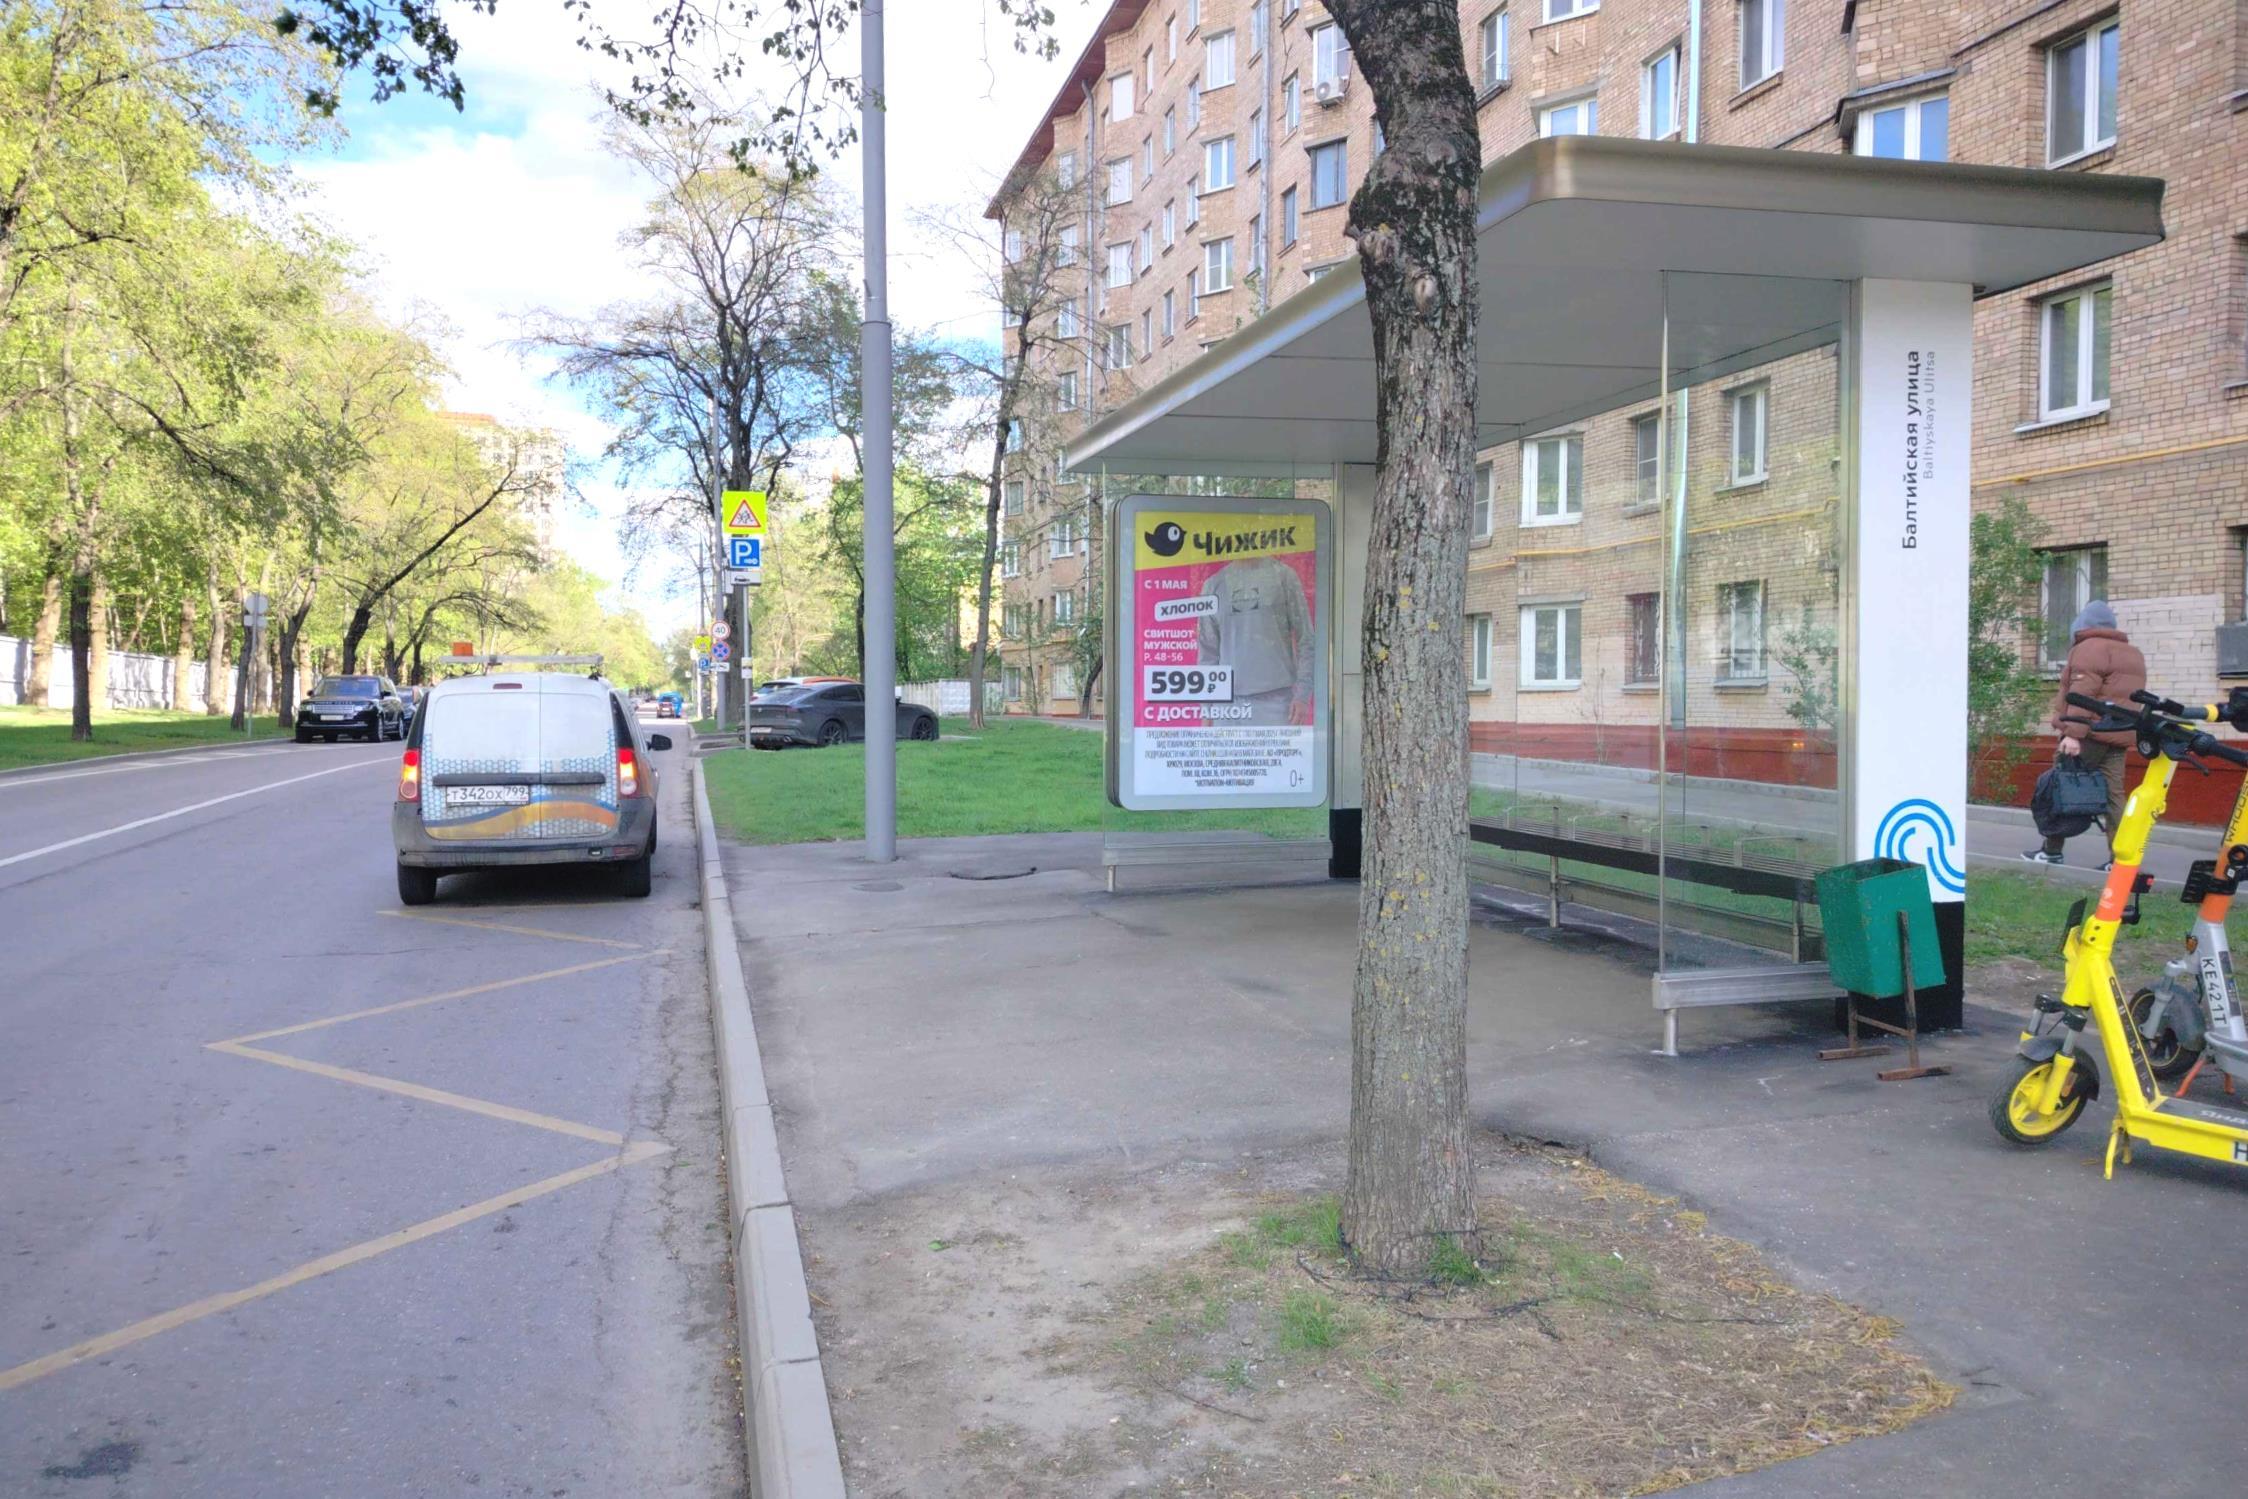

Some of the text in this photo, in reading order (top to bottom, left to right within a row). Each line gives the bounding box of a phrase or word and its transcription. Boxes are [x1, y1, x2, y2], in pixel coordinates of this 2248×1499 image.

[1923, 351, 1936, 479] Baltiyskaya Ulitsa
[1902, 350, 1922, 549] Балтийская улица
[735, 541, 752, 565] P
[1144, 579, 1188, 590] С 1 МАЯ
[1160, 600, 1214, 616] ХЛОПОК
[715, 626, 726, 634] 40
[1143, 629, 1195, 639] СВИТШОТ
[1143, 640, 1198, 650] МУЖСКОЙ
[1144, 652, 1184, 662] Р. 48-56
[1151, 671, 1227, 694] 599 00
[1143, 704, 1252, 721] С ДОСТАВКОЙ
[1290, 769, 1305, 787] 0+
[505, 786, 526, 796] 799
[2224, 779, 2248, 842] WHOOS
